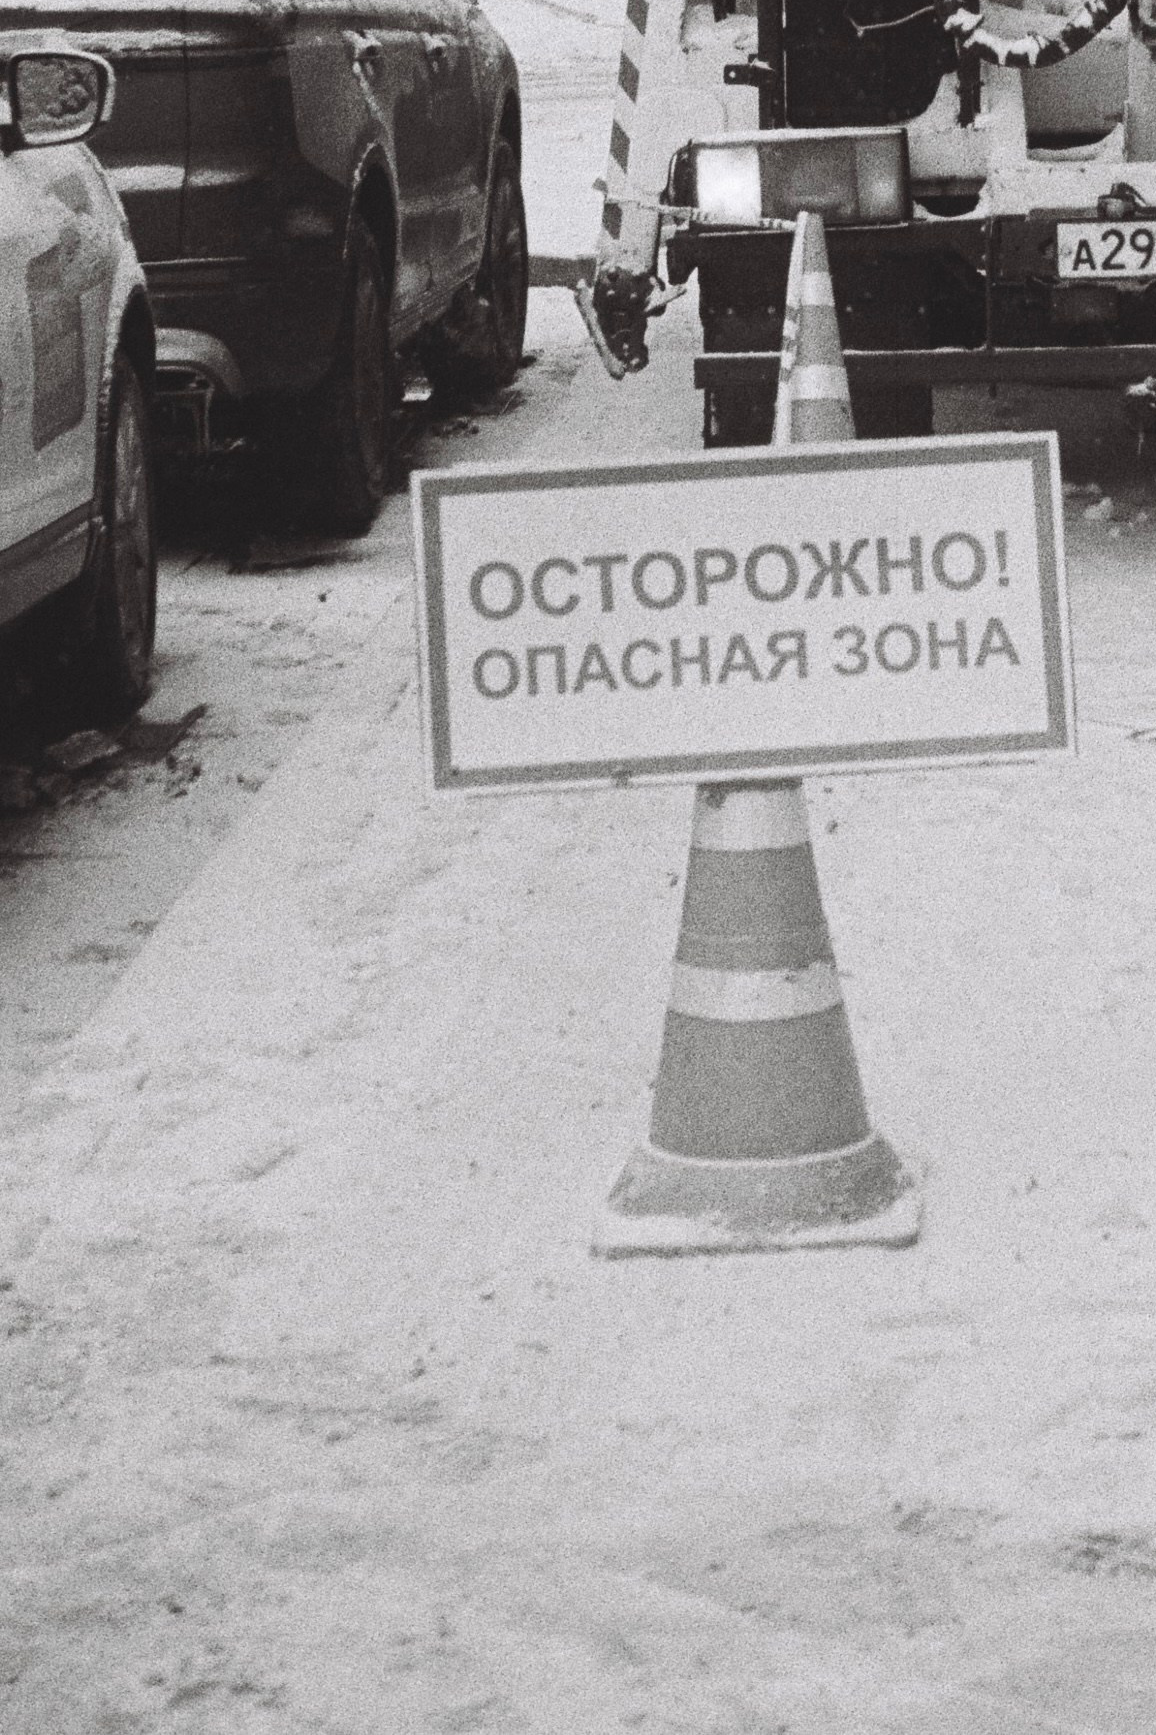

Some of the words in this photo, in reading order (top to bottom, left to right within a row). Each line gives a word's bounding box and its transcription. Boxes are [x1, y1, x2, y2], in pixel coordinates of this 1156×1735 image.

[468, 529, 1011, 620] ОСТОРОЖНО!
[472, 629, 809, 699] ОПАСНАЯ
[832, 617, 1021, 676] ЗОНА
